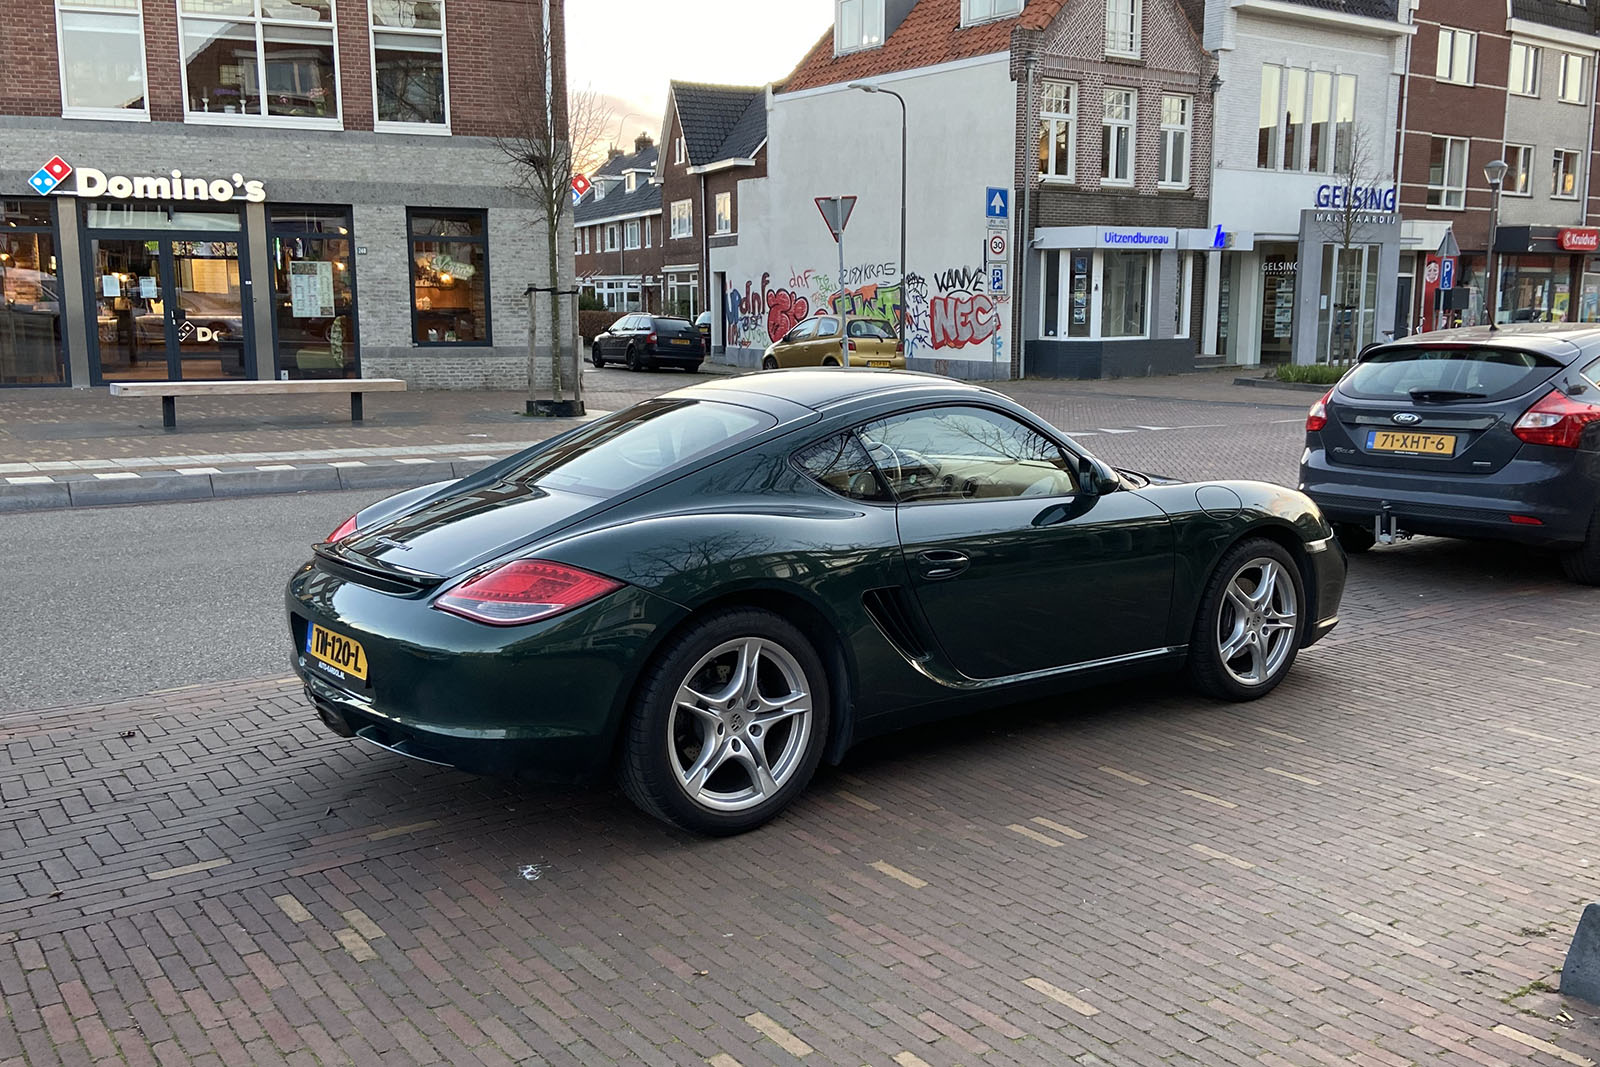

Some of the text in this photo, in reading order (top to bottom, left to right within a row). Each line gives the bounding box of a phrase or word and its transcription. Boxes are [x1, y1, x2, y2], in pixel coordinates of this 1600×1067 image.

[75, 167, 266, 202] Domino's
[1317, 185, 1396, 211] GELSING
[1315, 213, 1396, 225] MAKEAARDIJ
[993, 241, 1003, 250] 30
[1104, 232, 1169, 244] Uitzendbureau
[1444, 262, 1451, 277] P
[930, 294, 1001, 350] NEC
[1380, 433, 1446, 451] 71-XHT-6
